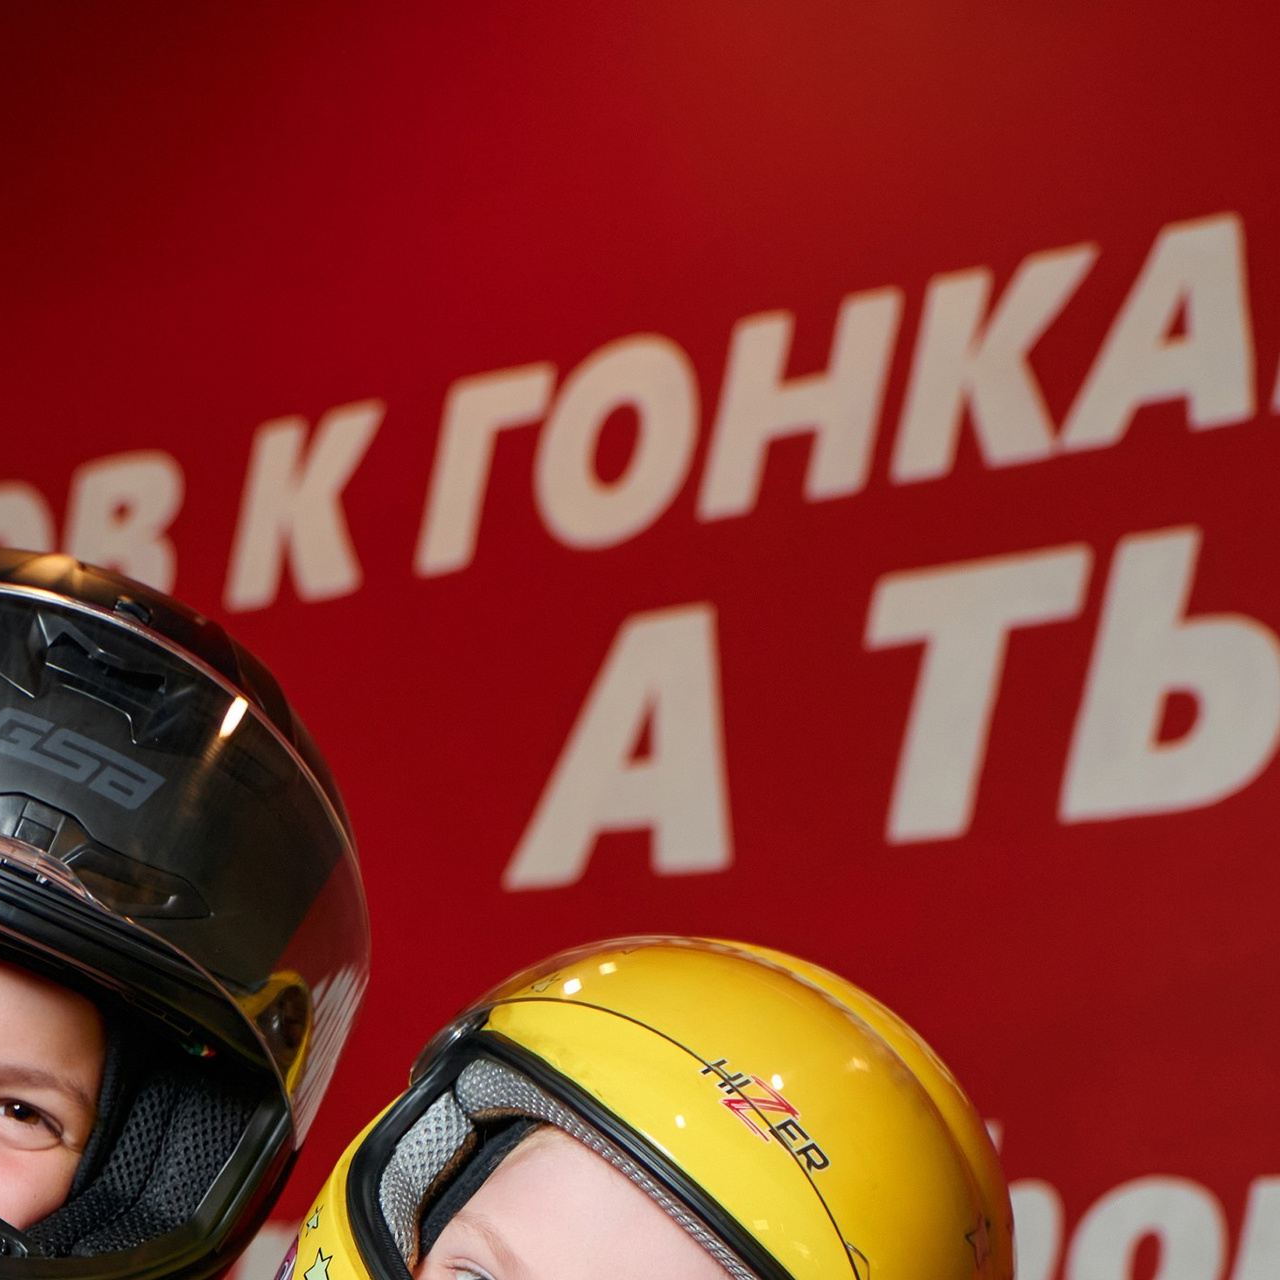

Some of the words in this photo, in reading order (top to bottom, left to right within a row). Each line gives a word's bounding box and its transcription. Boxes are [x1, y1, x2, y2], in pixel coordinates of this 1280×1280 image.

[223, 400, 387, 612] К
[413, 211, 1280, 577] ГОНКА
[502, 601, 733, 890] А
